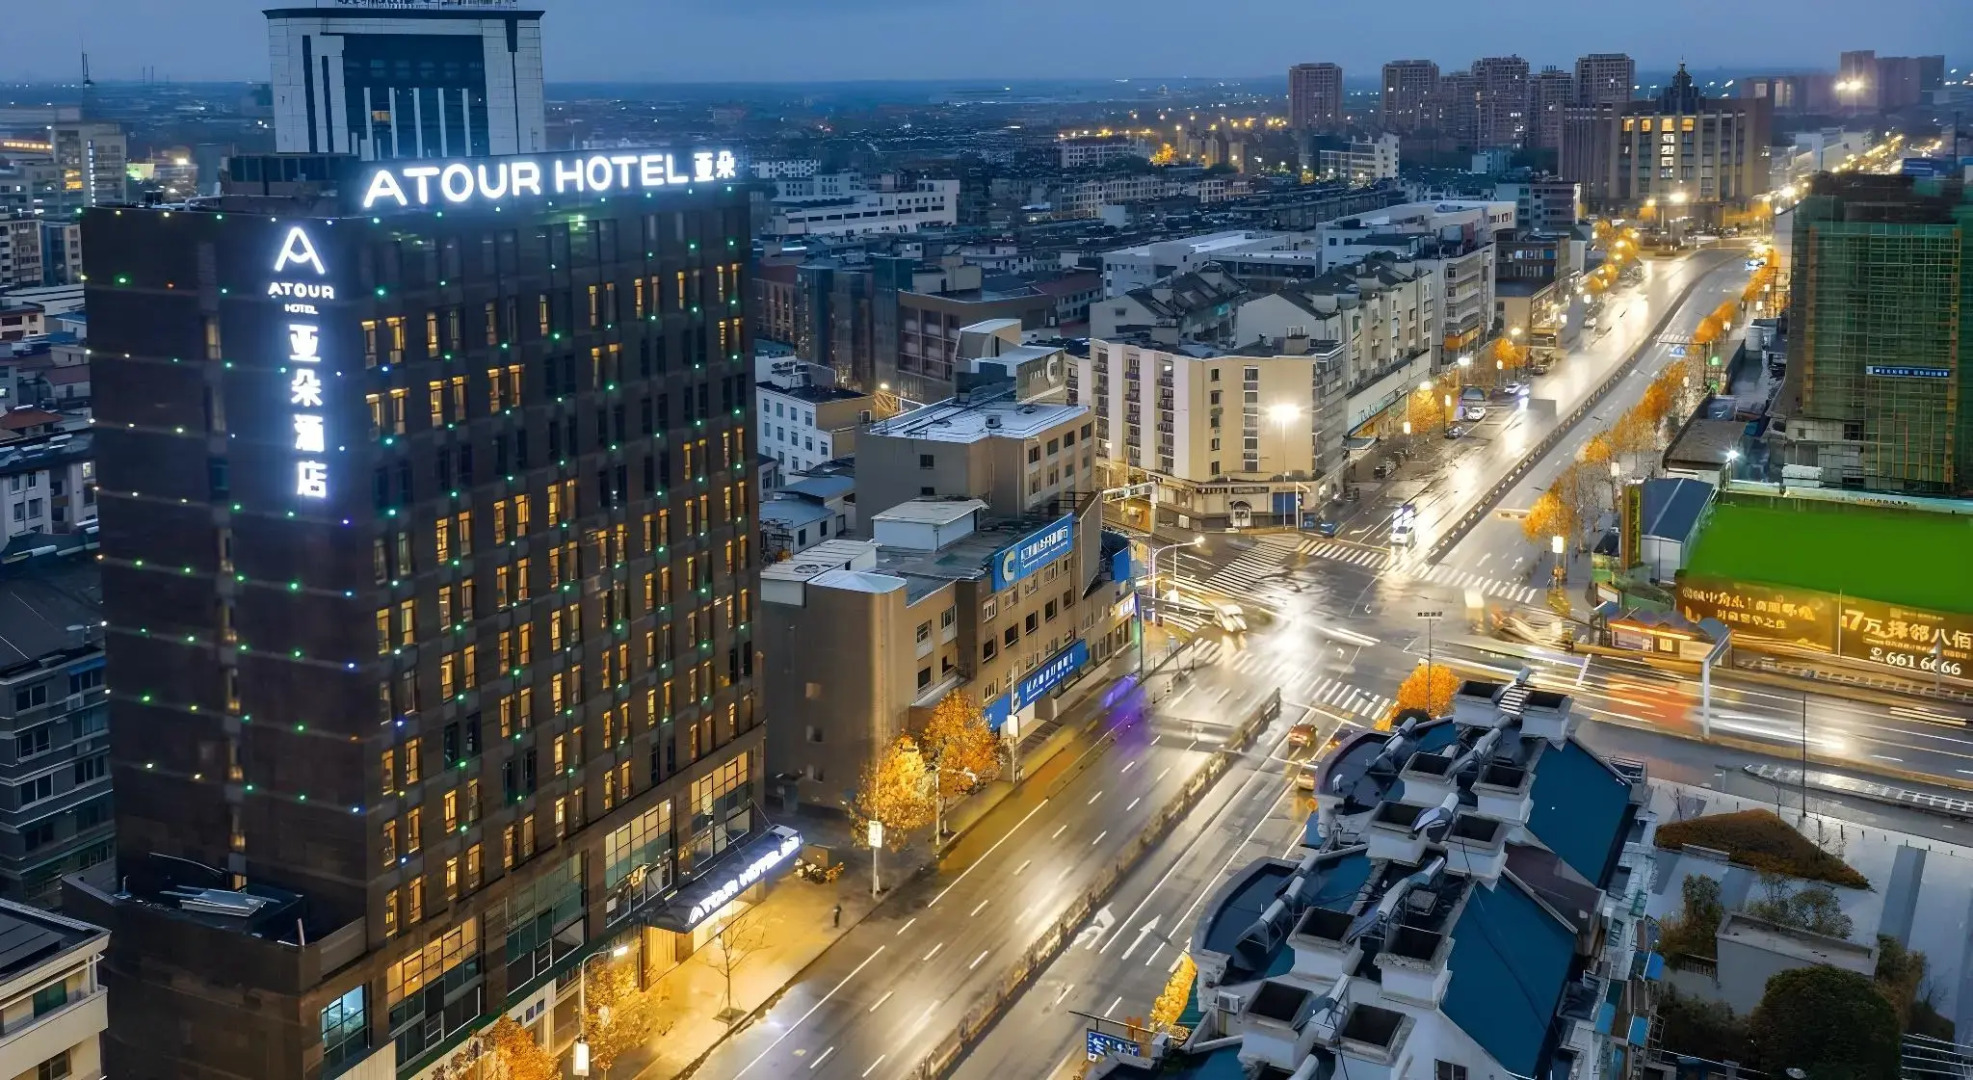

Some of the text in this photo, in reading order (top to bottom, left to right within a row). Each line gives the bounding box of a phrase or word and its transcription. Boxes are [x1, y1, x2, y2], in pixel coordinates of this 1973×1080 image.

[363, 150, 737, 208] ATOUR HOTEL 亚朵
[267, 282, 335, 299] ATOUR
[284, 304, 319, 315] HOTEL
[1886, 651, 1916, 669] 661
